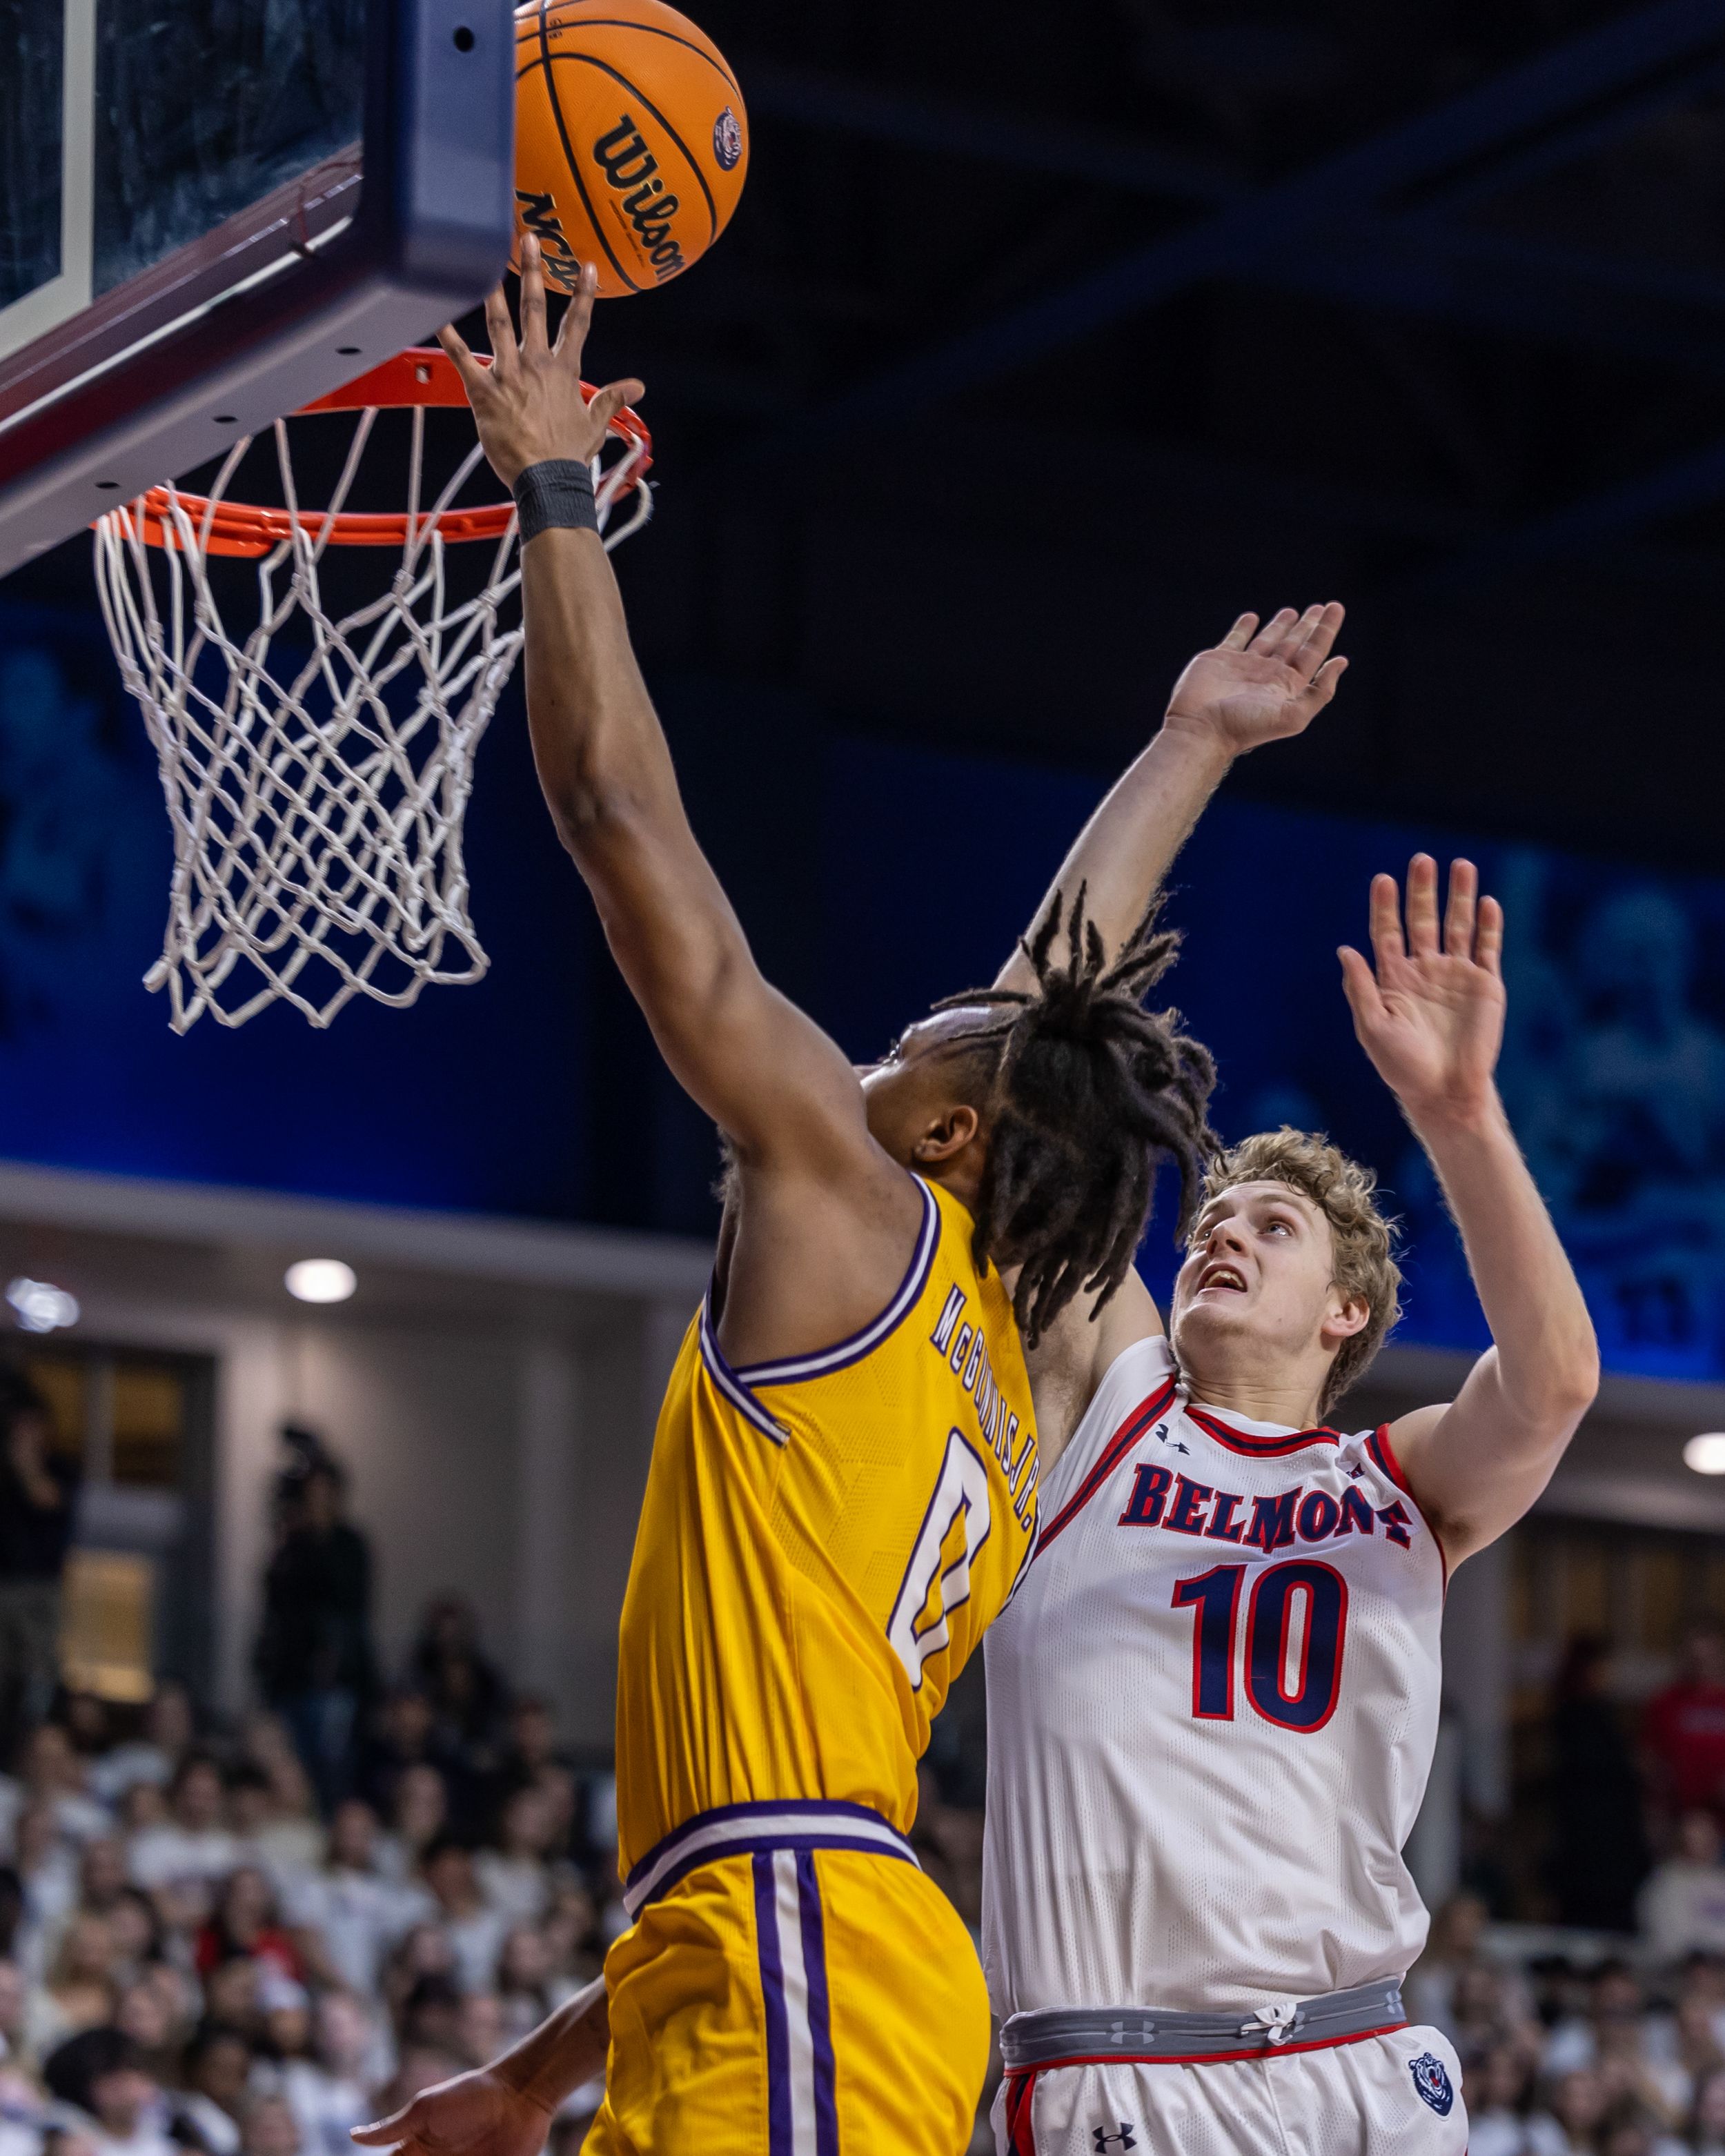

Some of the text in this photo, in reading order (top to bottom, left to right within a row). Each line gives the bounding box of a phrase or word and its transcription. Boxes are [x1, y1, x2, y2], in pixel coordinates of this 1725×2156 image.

[593, 114, 685, 281] Wilson
[885, 1425, 992, 1692] 0
[1009, 1434, 1041, 1532] JR.
[1117, 1463, 1413, 1553] BELMONT
[1170, 1559, 1348, 1734] 10
